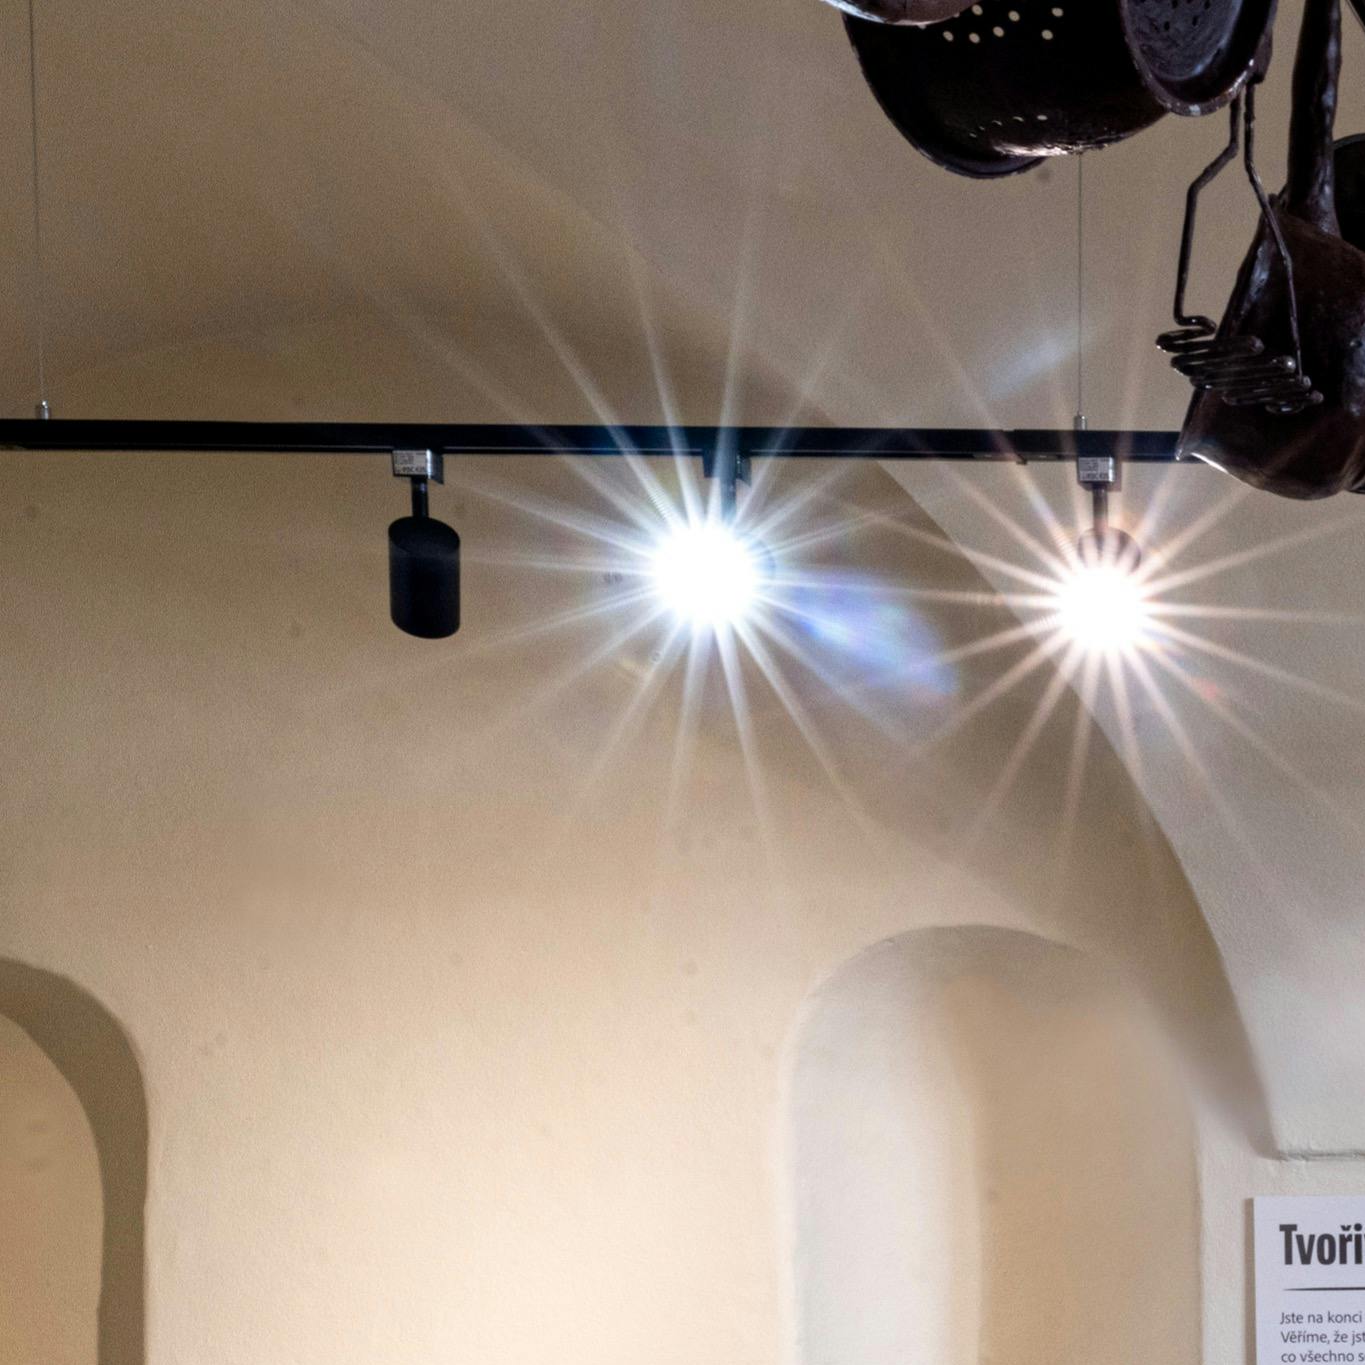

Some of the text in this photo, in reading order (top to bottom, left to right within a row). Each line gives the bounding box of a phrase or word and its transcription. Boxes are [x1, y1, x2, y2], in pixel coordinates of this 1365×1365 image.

[1280, 1312, 1303, 1325] Jste
[1308, 1314, 1323, 1324] na
[1328, 1311, 1362, 1323] konci
[1281, 1331, 1330, 1344] Věříme,
[1334, 1330, 1348, 1343] že
[1281, 1353, 1296, 1363] co
[1300, 1350, 1354, 1362] všechno
